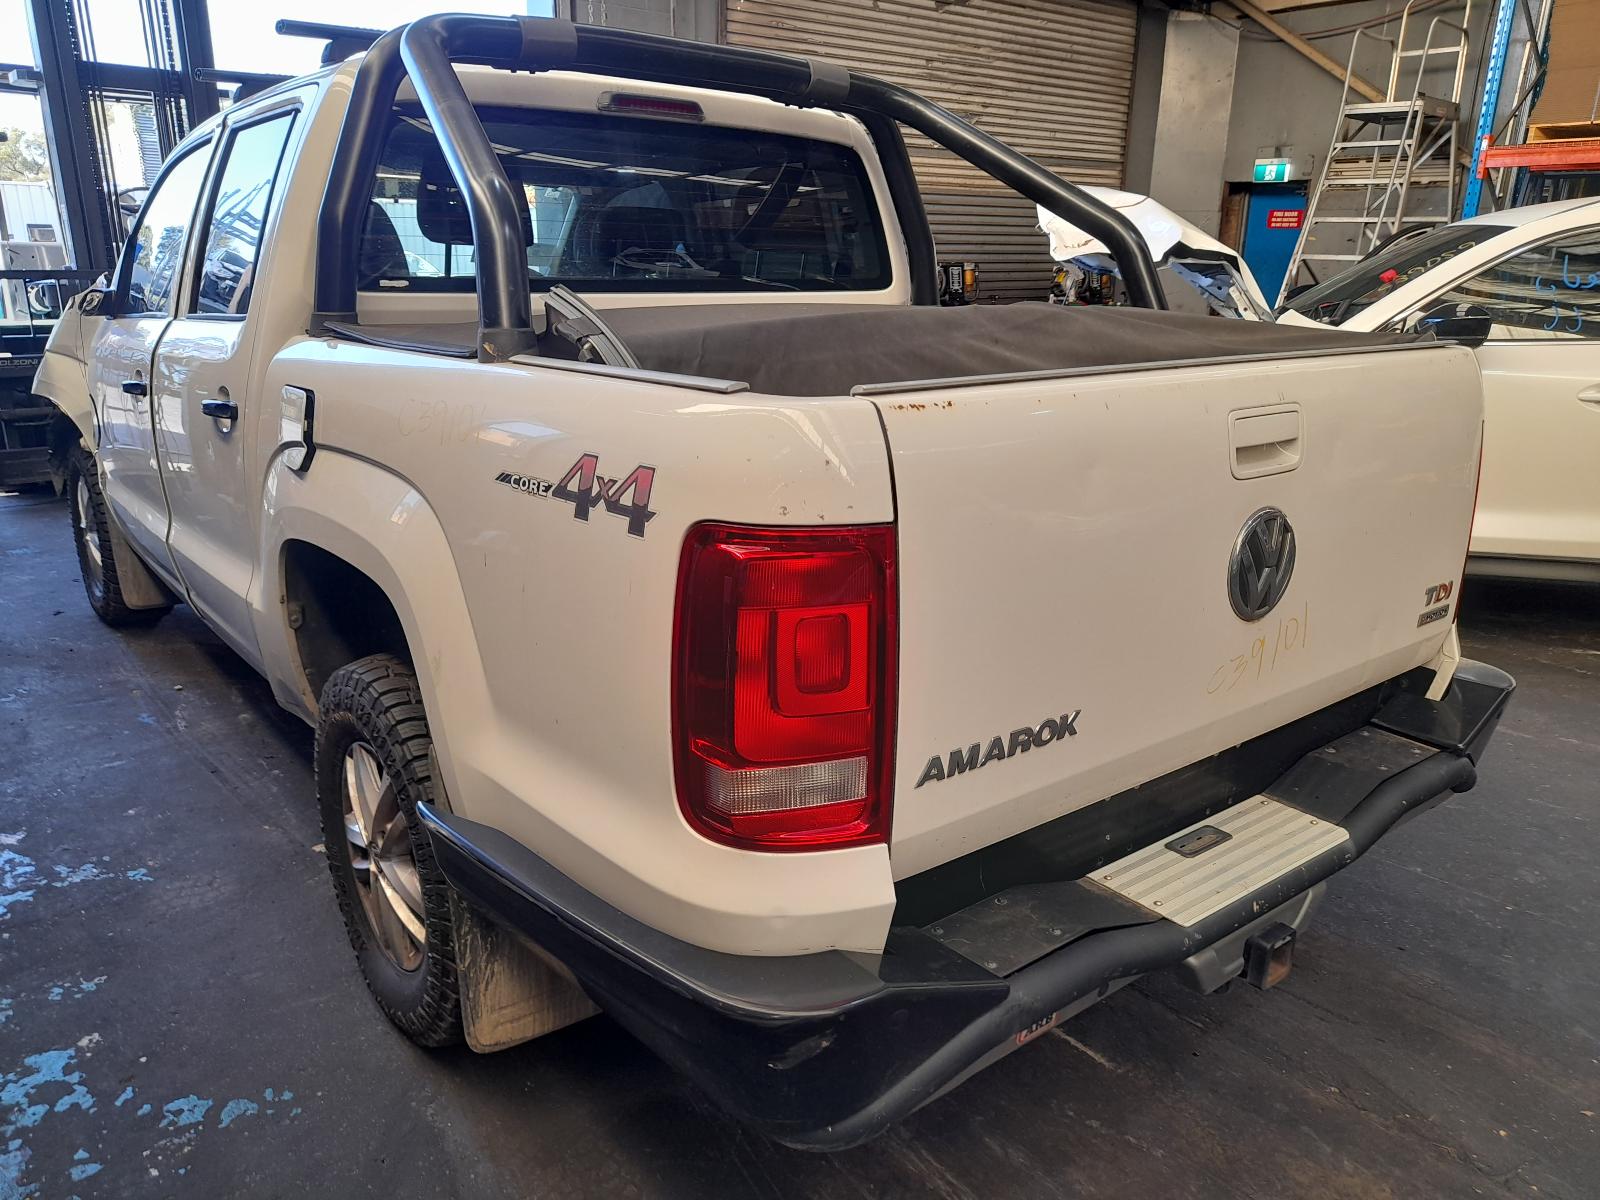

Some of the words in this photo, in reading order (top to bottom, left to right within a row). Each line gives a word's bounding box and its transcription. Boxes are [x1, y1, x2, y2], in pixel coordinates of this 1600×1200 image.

[508, 473, 551, 499] CORE
[551, 452, 659, 539] 4x4
[1424, 580, 1454, 607] TDI
[914, 708, 1082, 789] AMAROK
